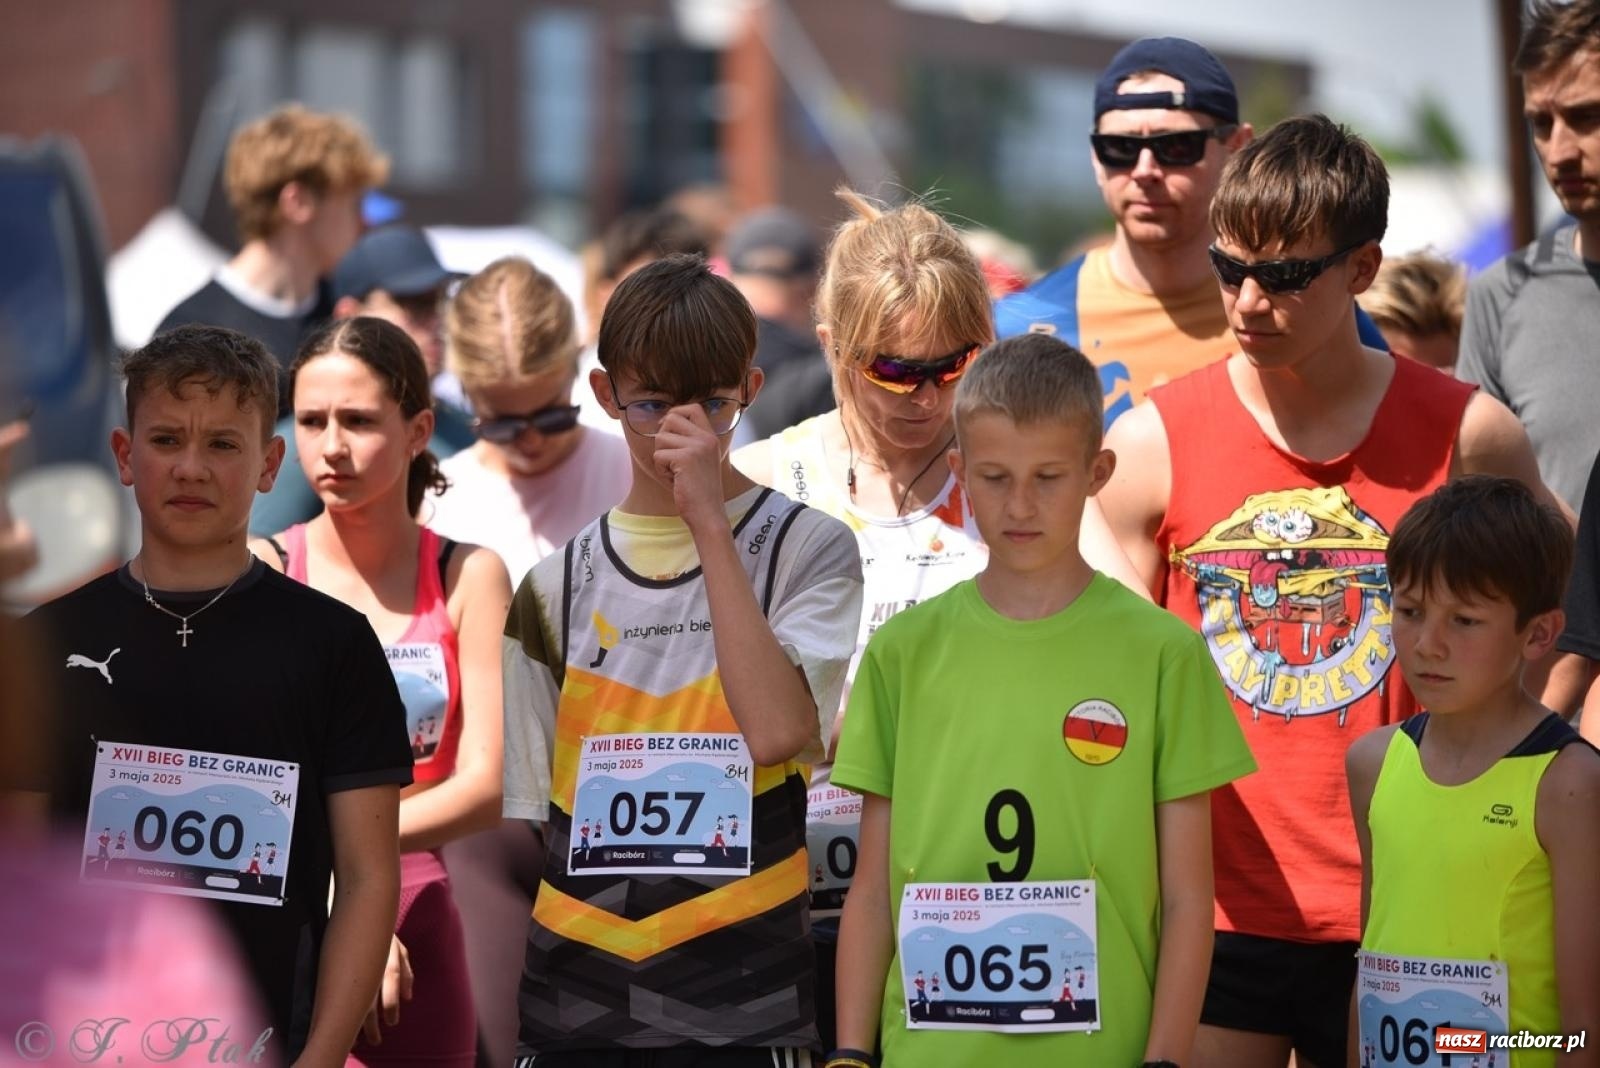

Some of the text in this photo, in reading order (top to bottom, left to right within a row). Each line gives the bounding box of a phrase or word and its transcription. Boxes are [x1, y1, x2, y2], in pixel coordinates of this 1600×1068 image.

[791, 460, 810, 501] deep
[624, 623, 684, 640] inżynieria
[1208, 594, 1265, 692] STAY
[1270, 595, 1393, 708] PRETTY
[590, 737, 739, 754] XVII BIEG BEZ GRANIC
[112, 747, 143, 762] XVII
[147, 751, 184, 766] BIEG
[188, 754, 219, 770] BEZ
[223, 759, 285, 778] GRANIC
[587, 759, 644, 773] 3 maja 2025
[109, 769, 116, 779] 3
[119, 771, 150, 784] maja
[152, 773, 182, 785] 2025
[609, 791, 706, 837] 057
[834, 803, 861, 815] 2025
[133, 805, 244, 861] 060
[984, 788, 1036, 883] 9
[612, 851, 646, 859] Racibórz
[914, 885, 1081, 901] XVII BIEG BEZ GRANIC
[912, 910, 981, 923] 3 maja 2025
[944, 943, 1052, 993] 065
[1377, 958, 1400, 973] BIEG
[1403, 961, 1427, 975] BEZ
[1430, 963, 1492, 979] GRANIC
[1367, 979, 1381, 991] maja
[1382, 981, 1400, 992] 2025
[956, 1005, 991, 1017] Racibórz
